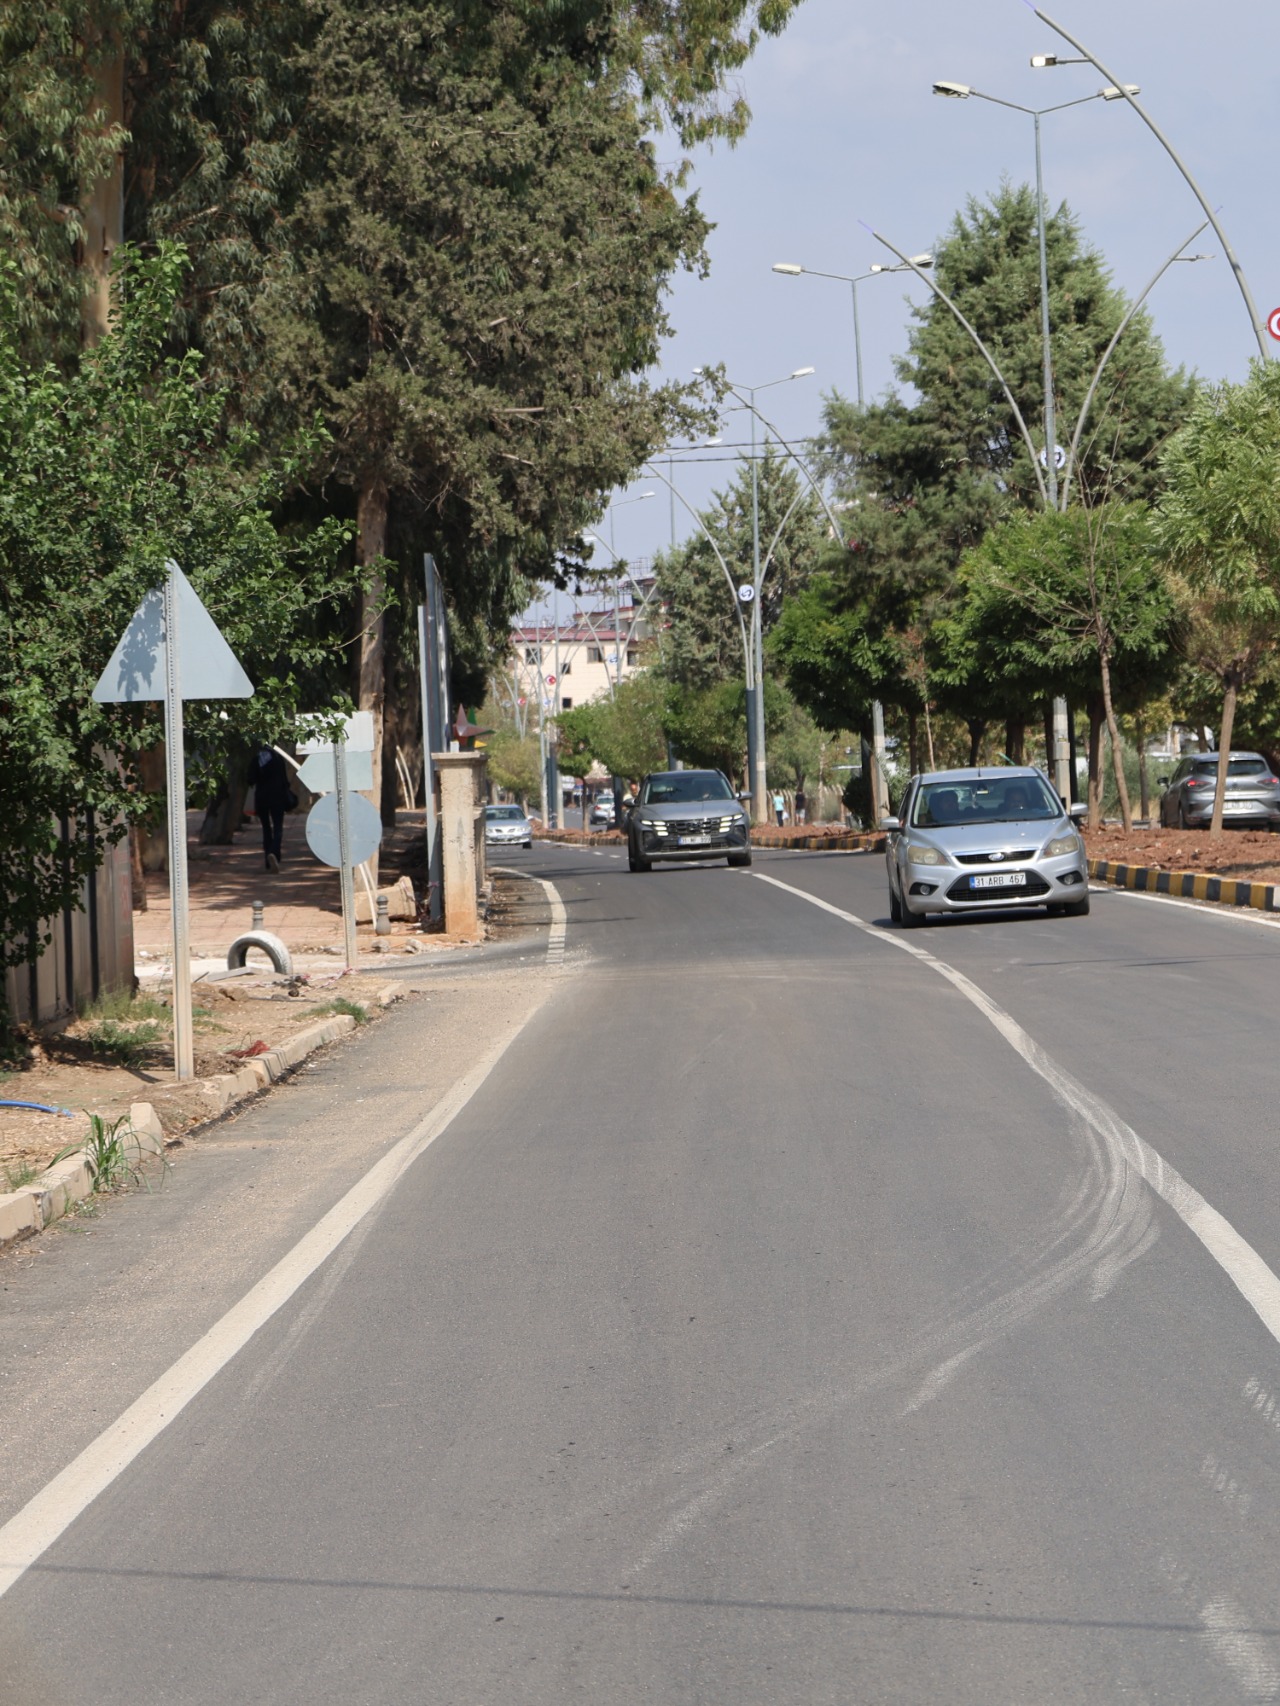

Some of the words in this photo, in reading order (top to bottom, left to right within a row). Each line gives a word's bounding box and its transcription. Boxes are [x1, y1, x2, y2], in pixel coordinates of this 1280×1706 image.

[975, 878, 985, 887] 31
[988, 876, 1004, 886] ARB
[1009, 874, 1025, 885] 467
